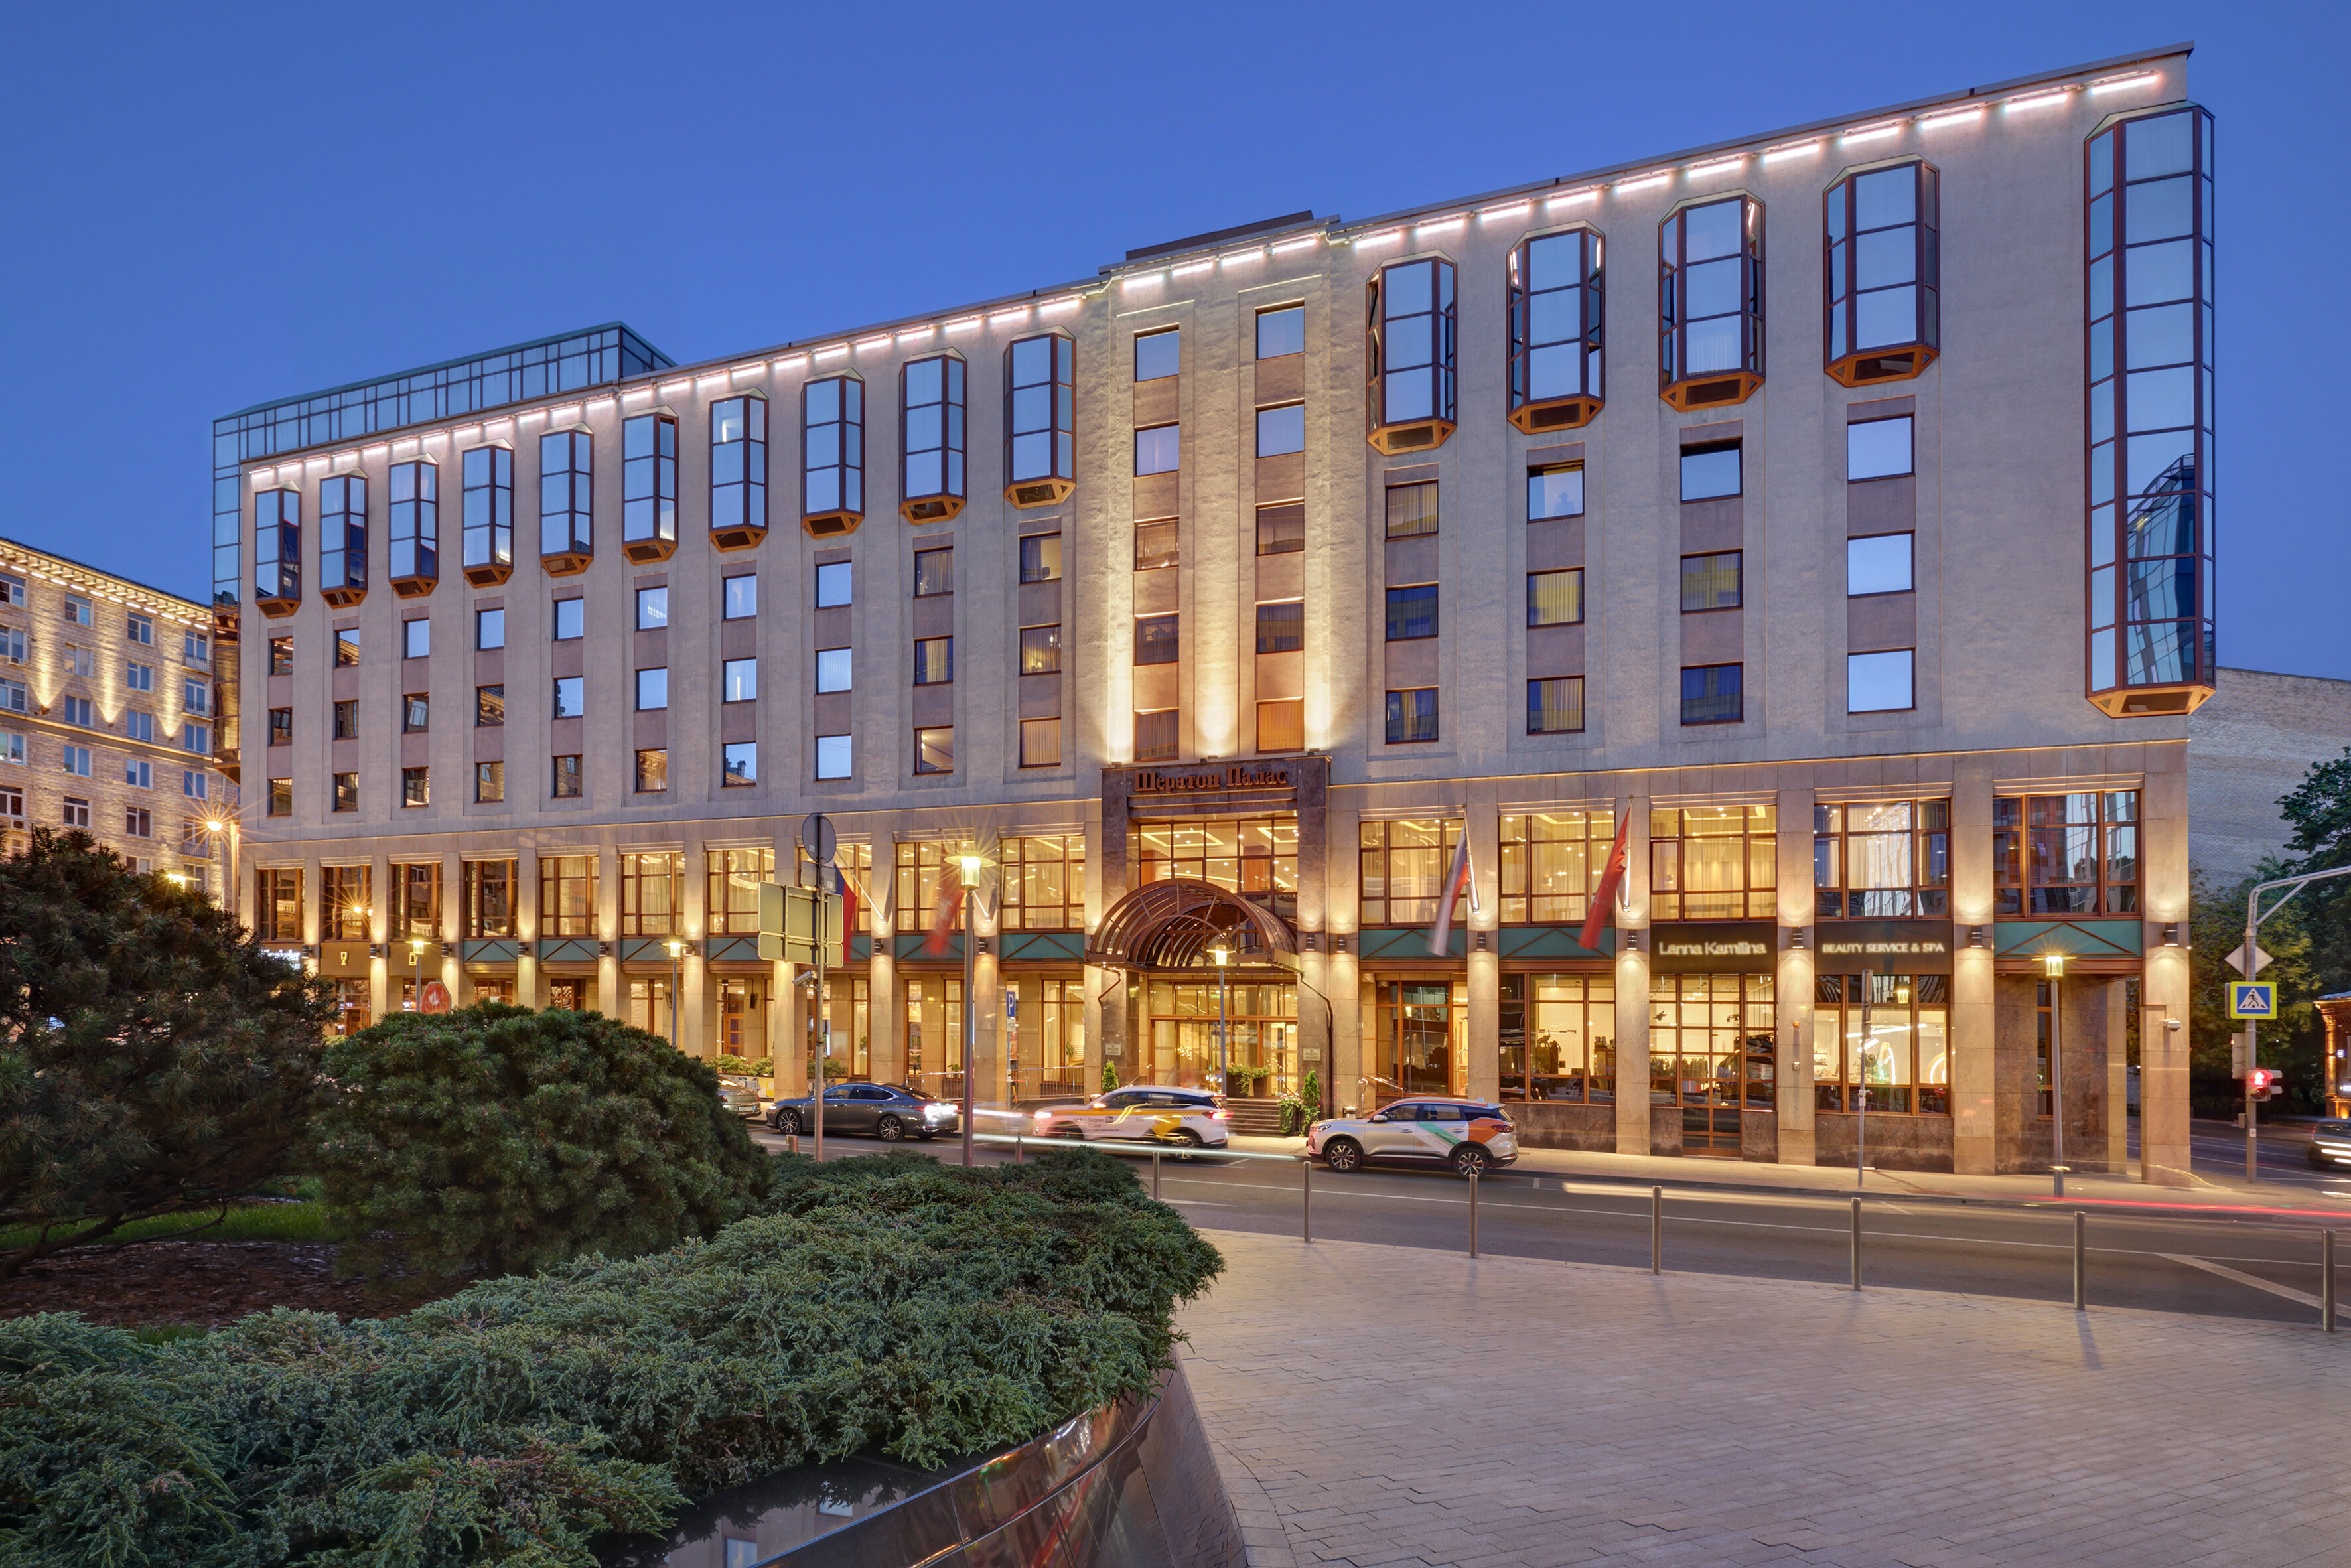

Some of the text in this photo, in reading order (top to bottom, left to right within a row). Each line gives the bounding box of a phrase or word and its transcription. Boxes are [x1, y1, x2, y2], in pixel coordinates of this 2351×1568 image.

[1134, 766, 1288, 794] Шератон Палас
[1659, 942, 1703, 955] Lanna
[1822, 943, 1944, 953] BEAUTY SERVICE & SPA
[1009, 994, 1014, 1015] P
